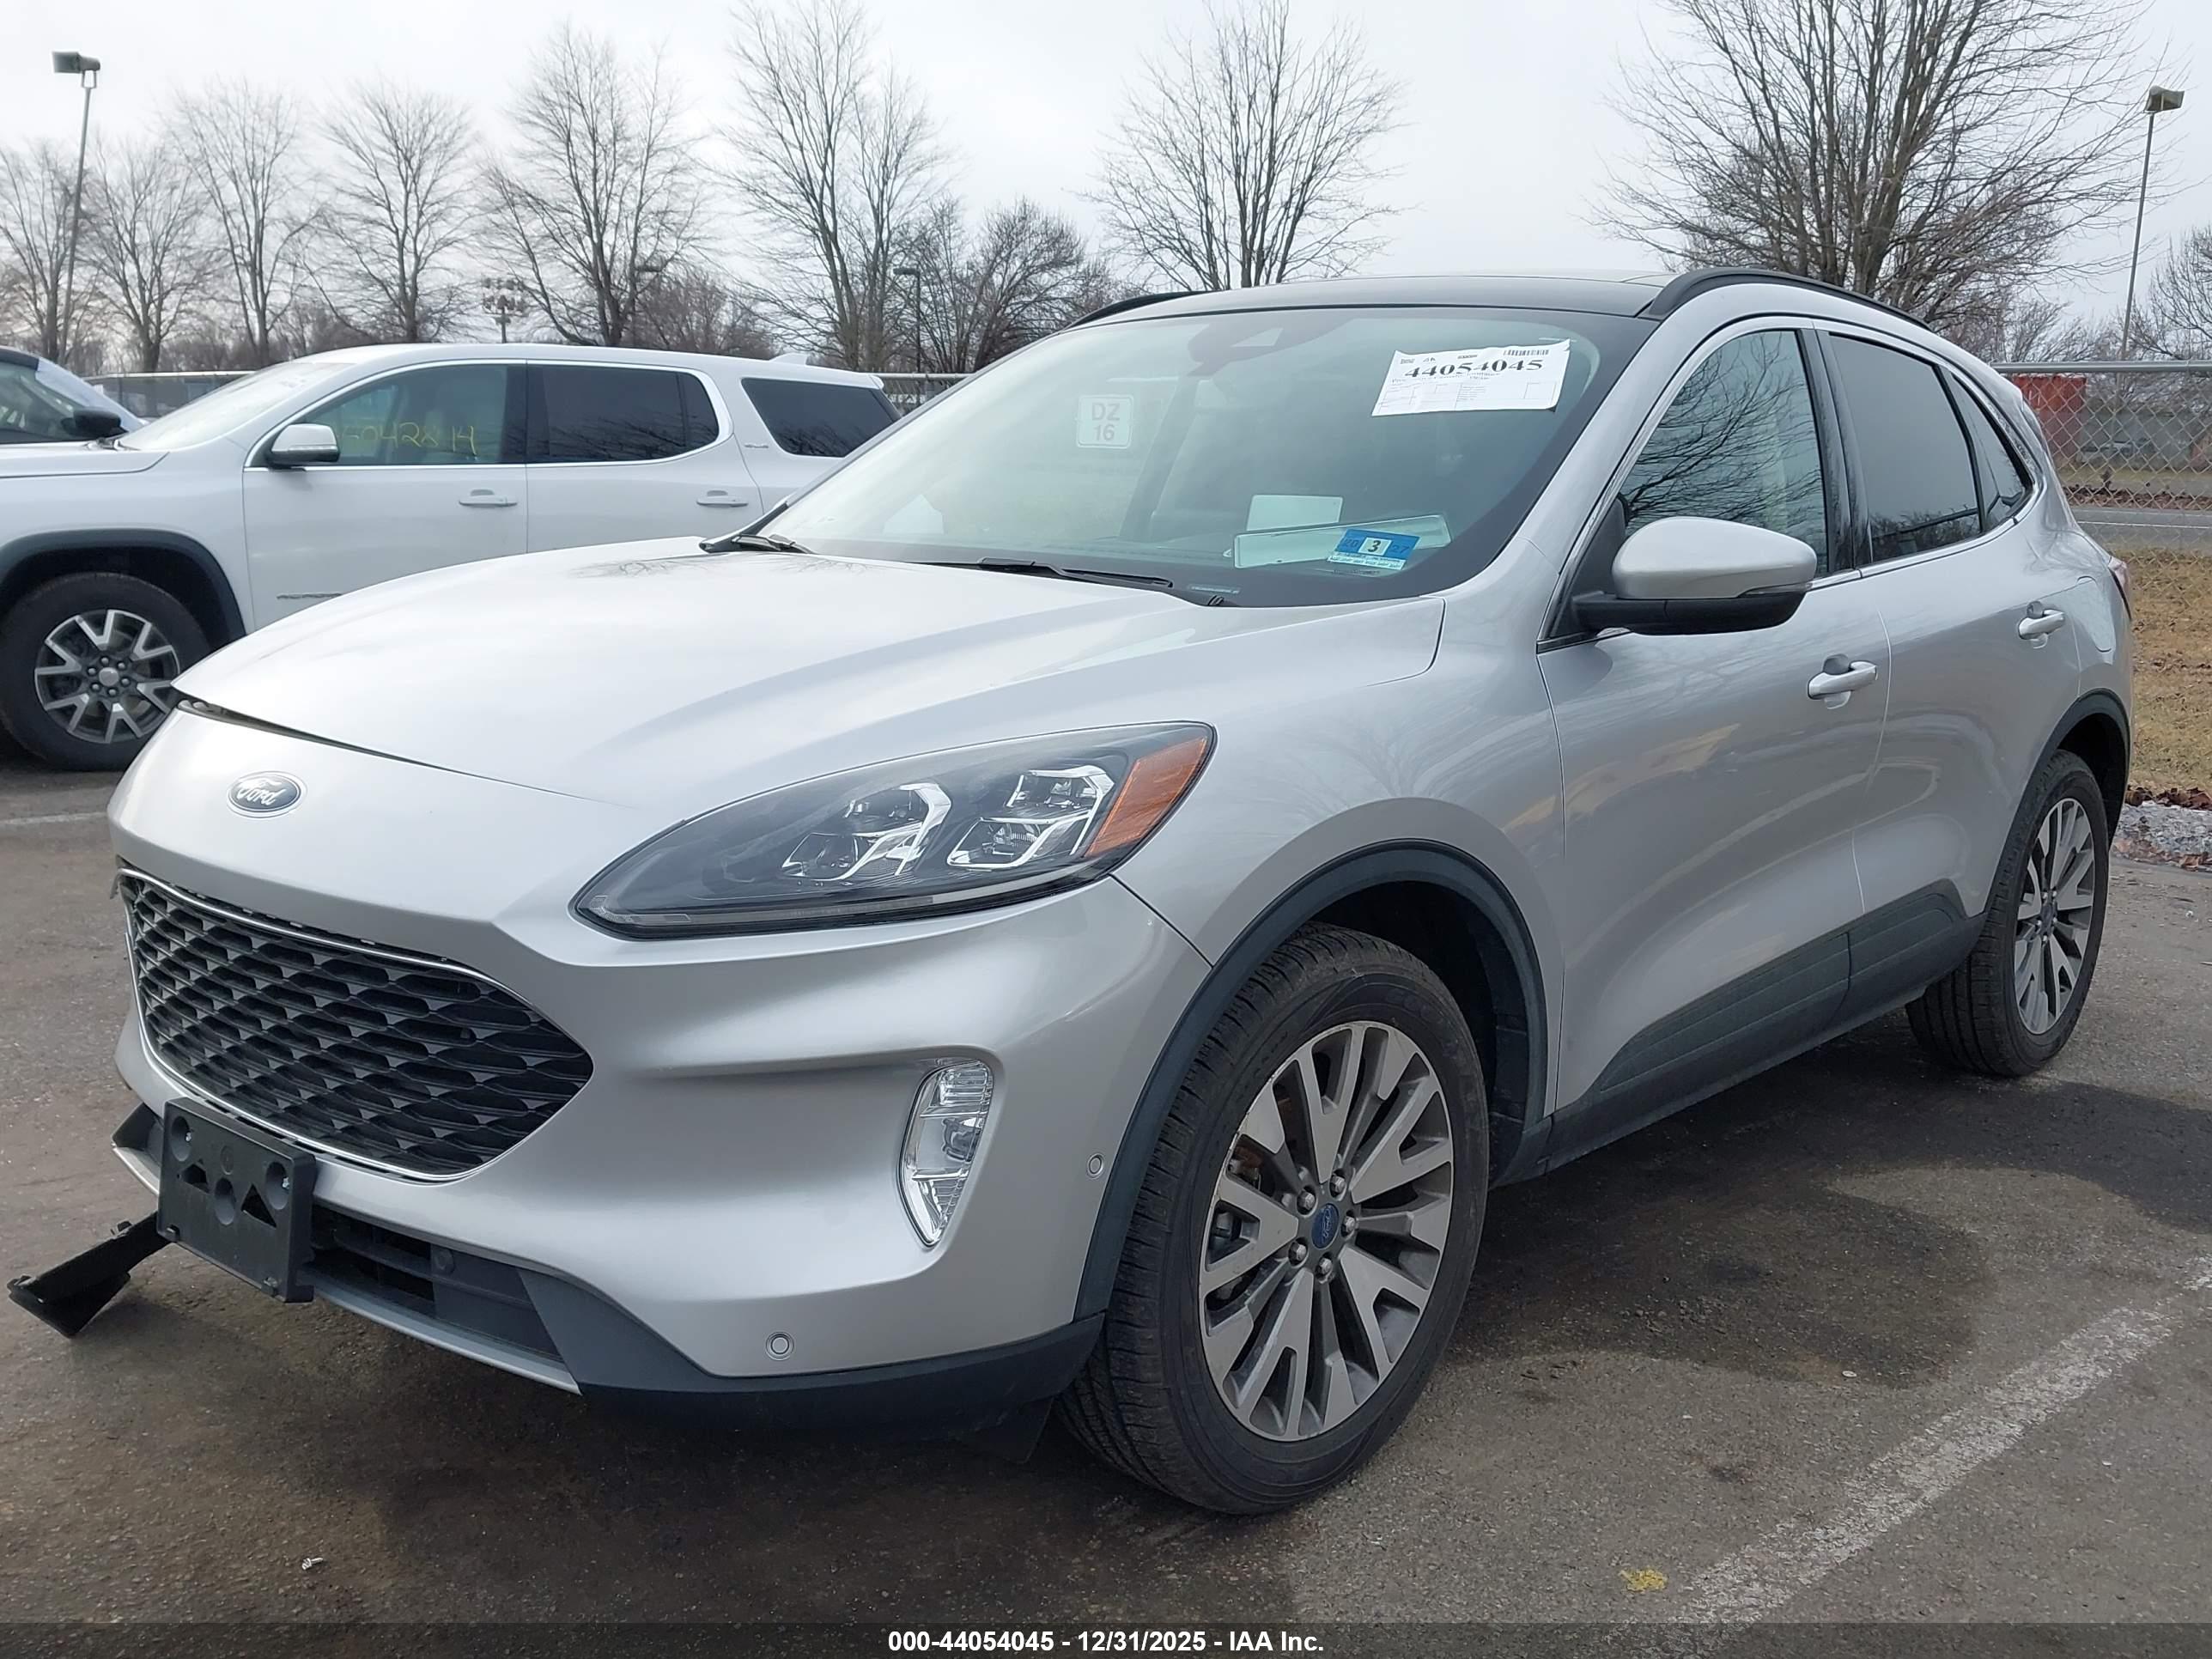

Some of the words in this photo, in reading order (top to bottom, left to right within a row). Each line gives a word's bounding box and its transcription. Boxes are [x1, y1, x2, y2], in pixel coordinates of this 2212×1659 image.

[1404, 359, 1544, 378] 44054045
[1091, 401, 1121, 422] DZ
[1092, 423, 1115, 441] 16
[1367, 539, 1382, 552] 3
